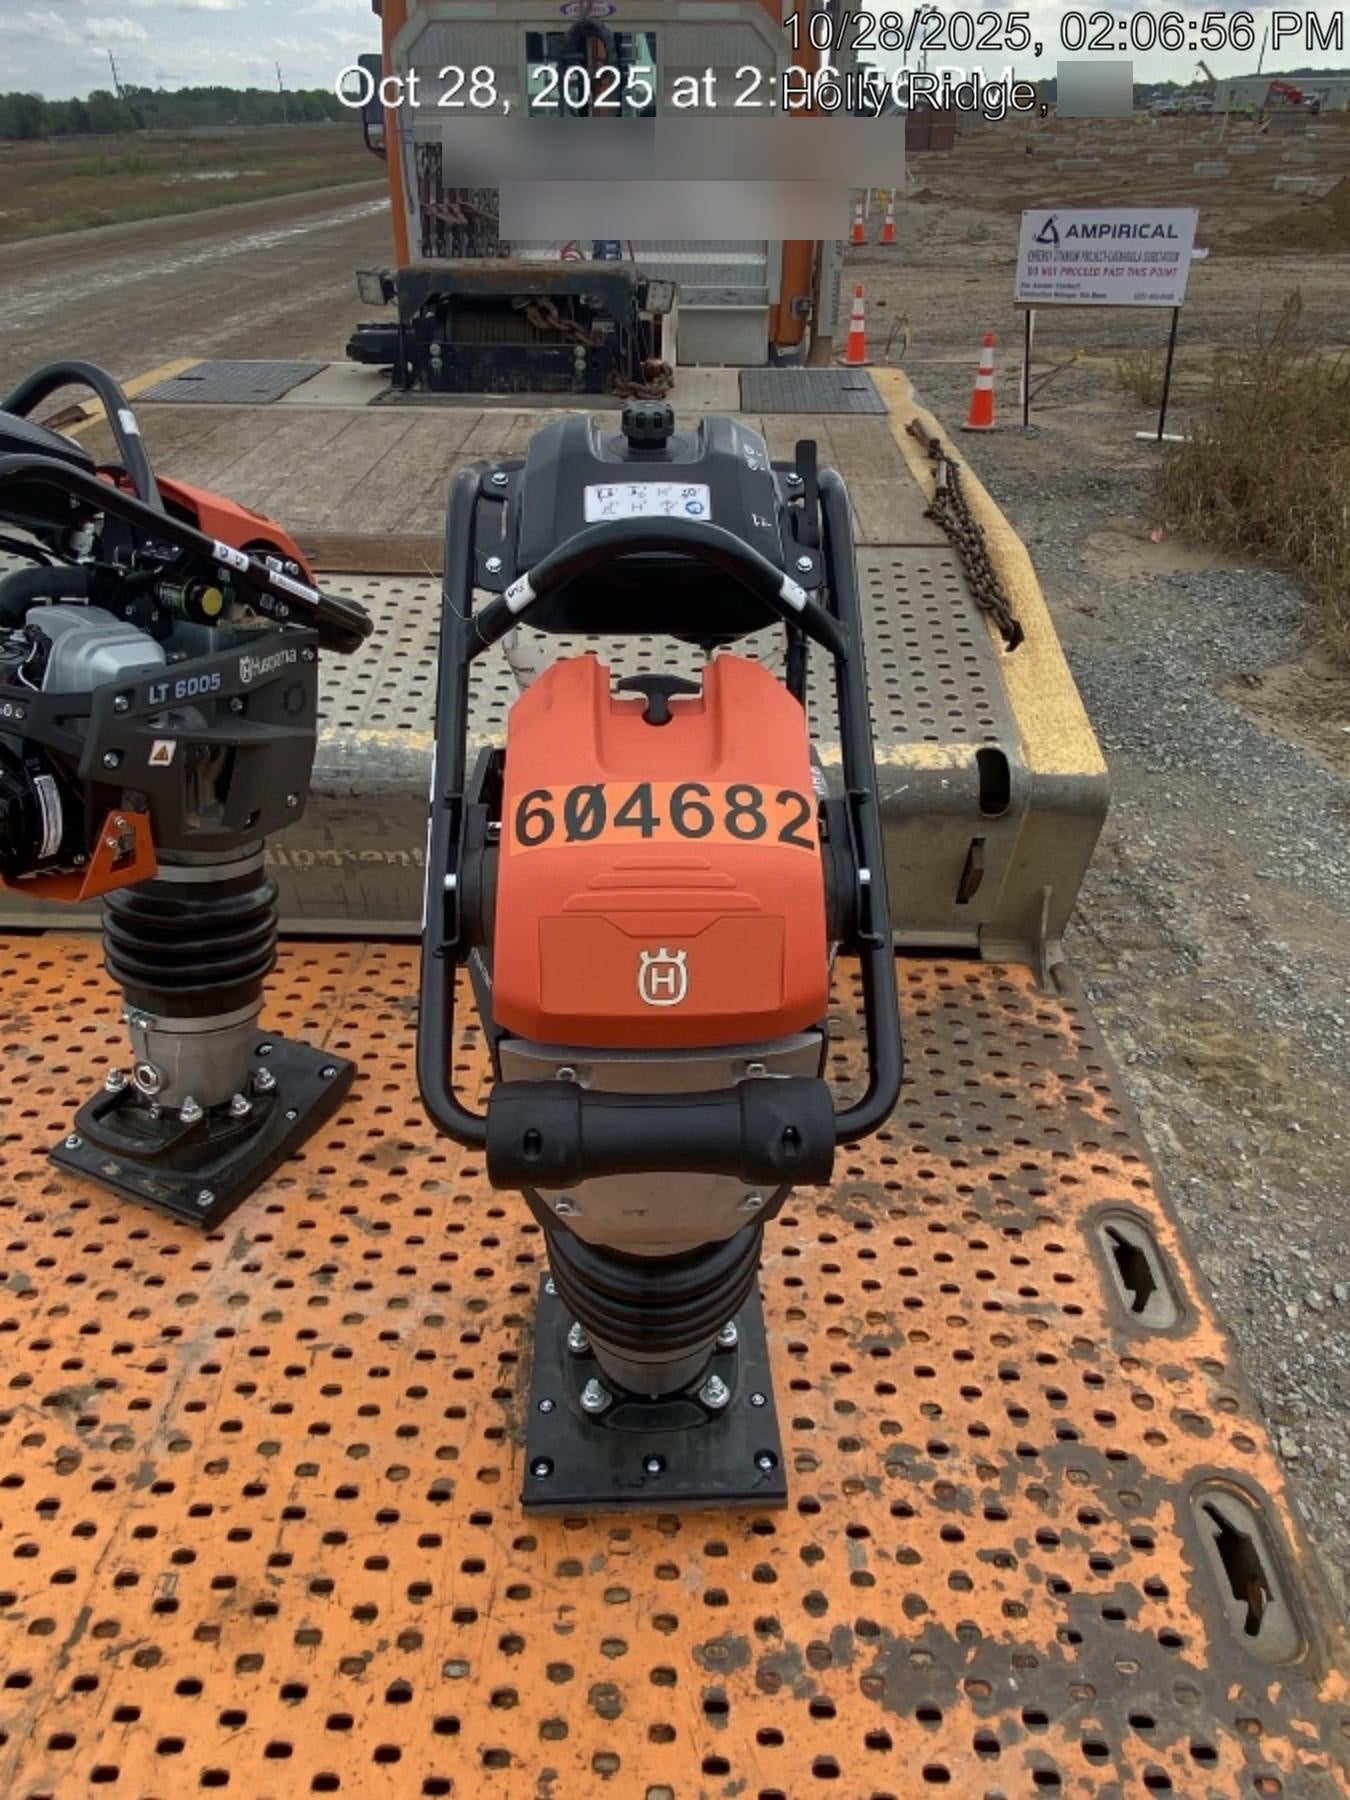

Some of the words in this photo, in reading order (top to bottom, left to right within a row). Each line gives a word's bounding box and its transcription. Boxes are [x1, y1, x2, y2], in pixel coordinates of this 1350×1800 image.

[1065, 223, 1179, 239] AMPIRICAL
[1060, 267, 1101, 277] PROCEED
[149, 684, 169, 704] LT
[175, 673, 221, 699] 6005
[515, 783, 817, 850] 604682
